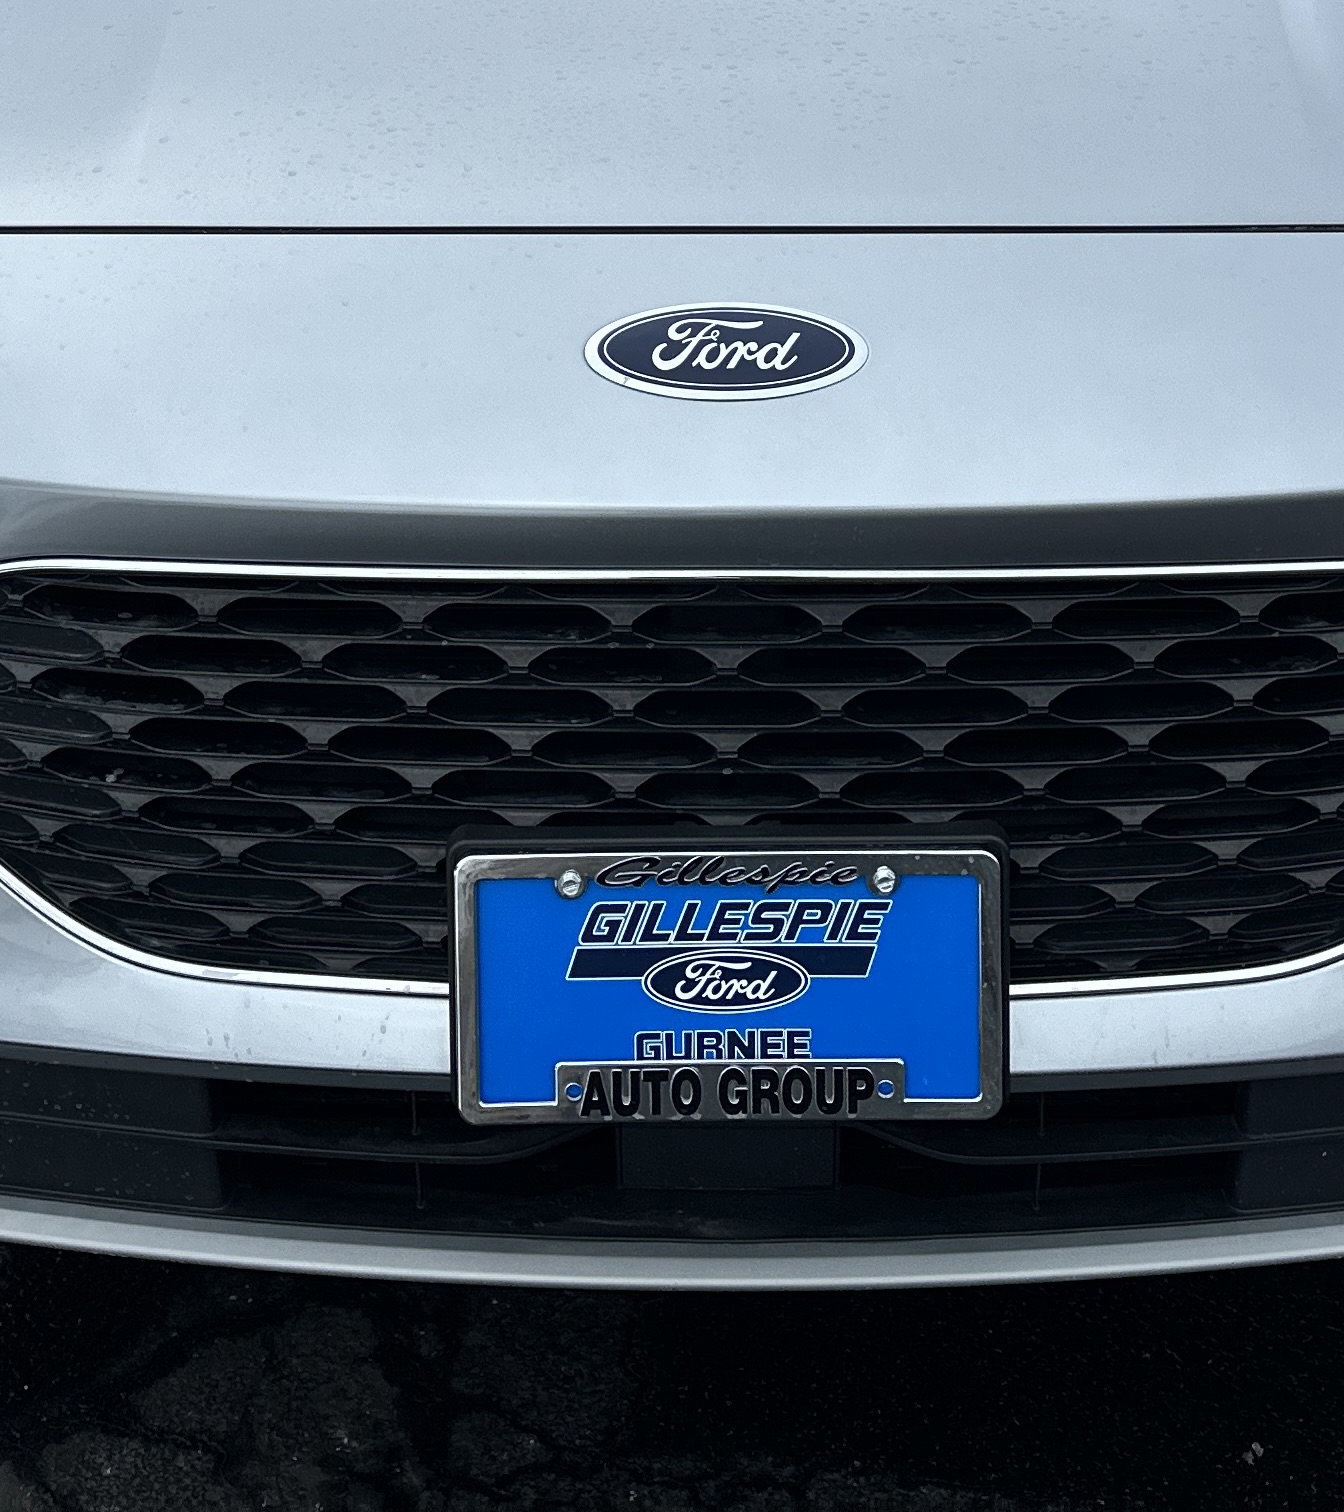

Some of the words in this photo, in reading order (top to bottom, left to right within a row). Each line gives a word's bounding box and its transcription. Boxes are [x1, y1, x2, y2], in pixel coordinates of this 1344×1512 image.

[651, 317, 801, 371] Ford
[594, 854, 860, 895] Gillespie
[578, 899, 894, 945] GILLESPIE
[674, 959, 778, 1000] Ford
[634, 1028, 812, 1061] GURNEE
[579, 1066, 703, 1118] AUTO
[718, 1065, 876, 1118] GROUP
